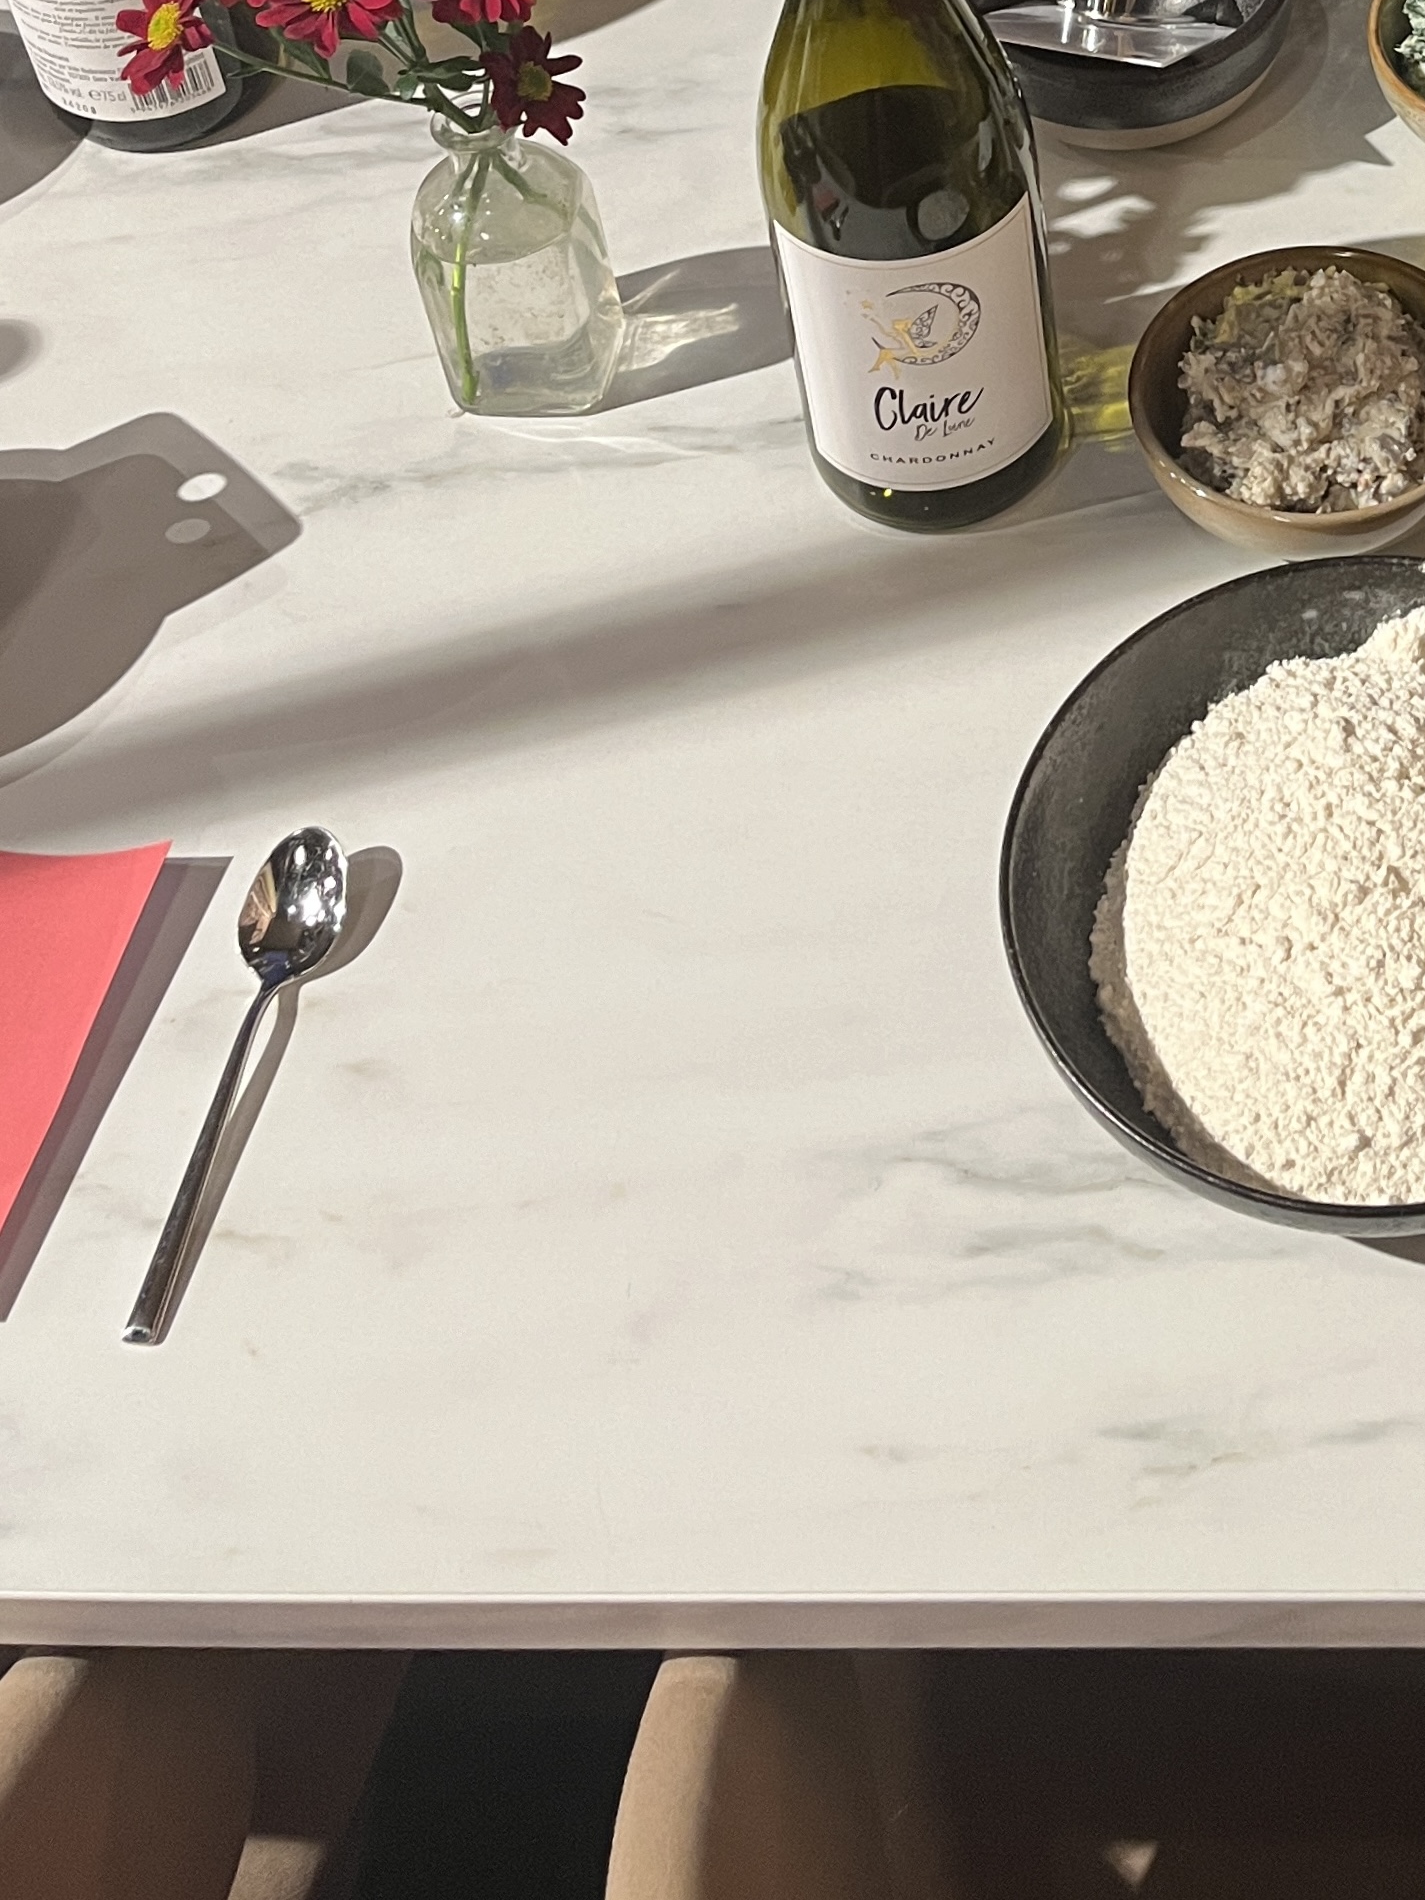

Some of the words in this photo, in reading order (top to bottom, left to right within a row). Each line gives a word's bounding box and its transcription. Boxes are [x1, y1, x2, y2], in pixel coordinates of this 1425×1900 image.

[873, 386, 985, 431] Claire
[914, 423, 938, 441] De
[942, 417, 976, 438] Lune
[869, 437, 996, 465] CHARDONNAY
